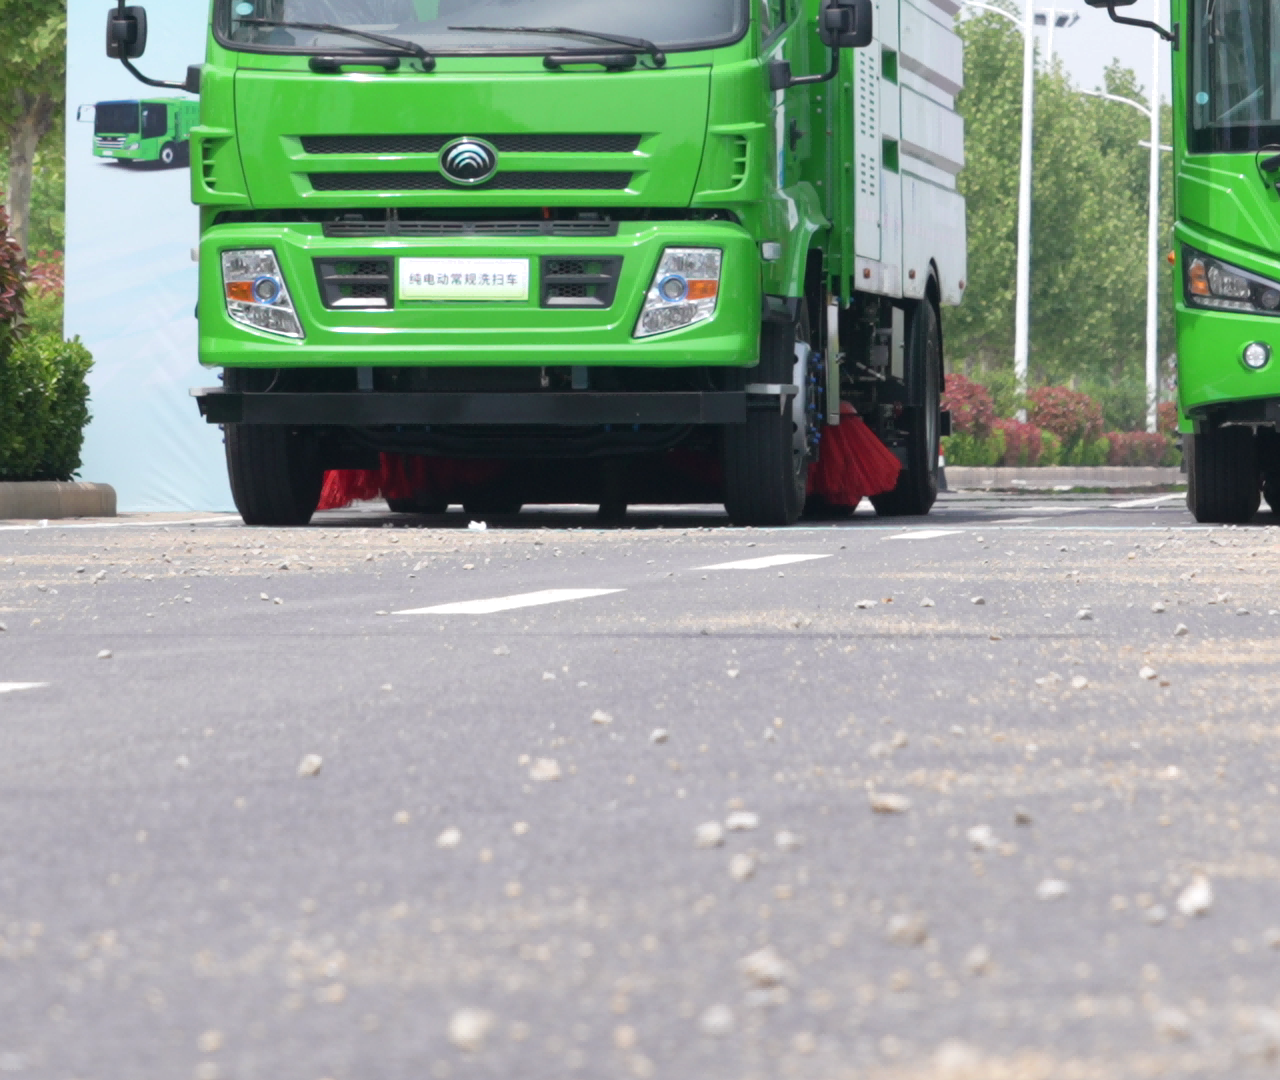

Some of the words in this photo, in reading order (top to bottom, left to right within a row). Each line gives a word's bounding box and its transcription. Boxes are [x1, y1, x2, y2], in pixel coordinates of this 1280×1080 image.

[408, 273, 518, 286] 纯电动常规洗扫车
